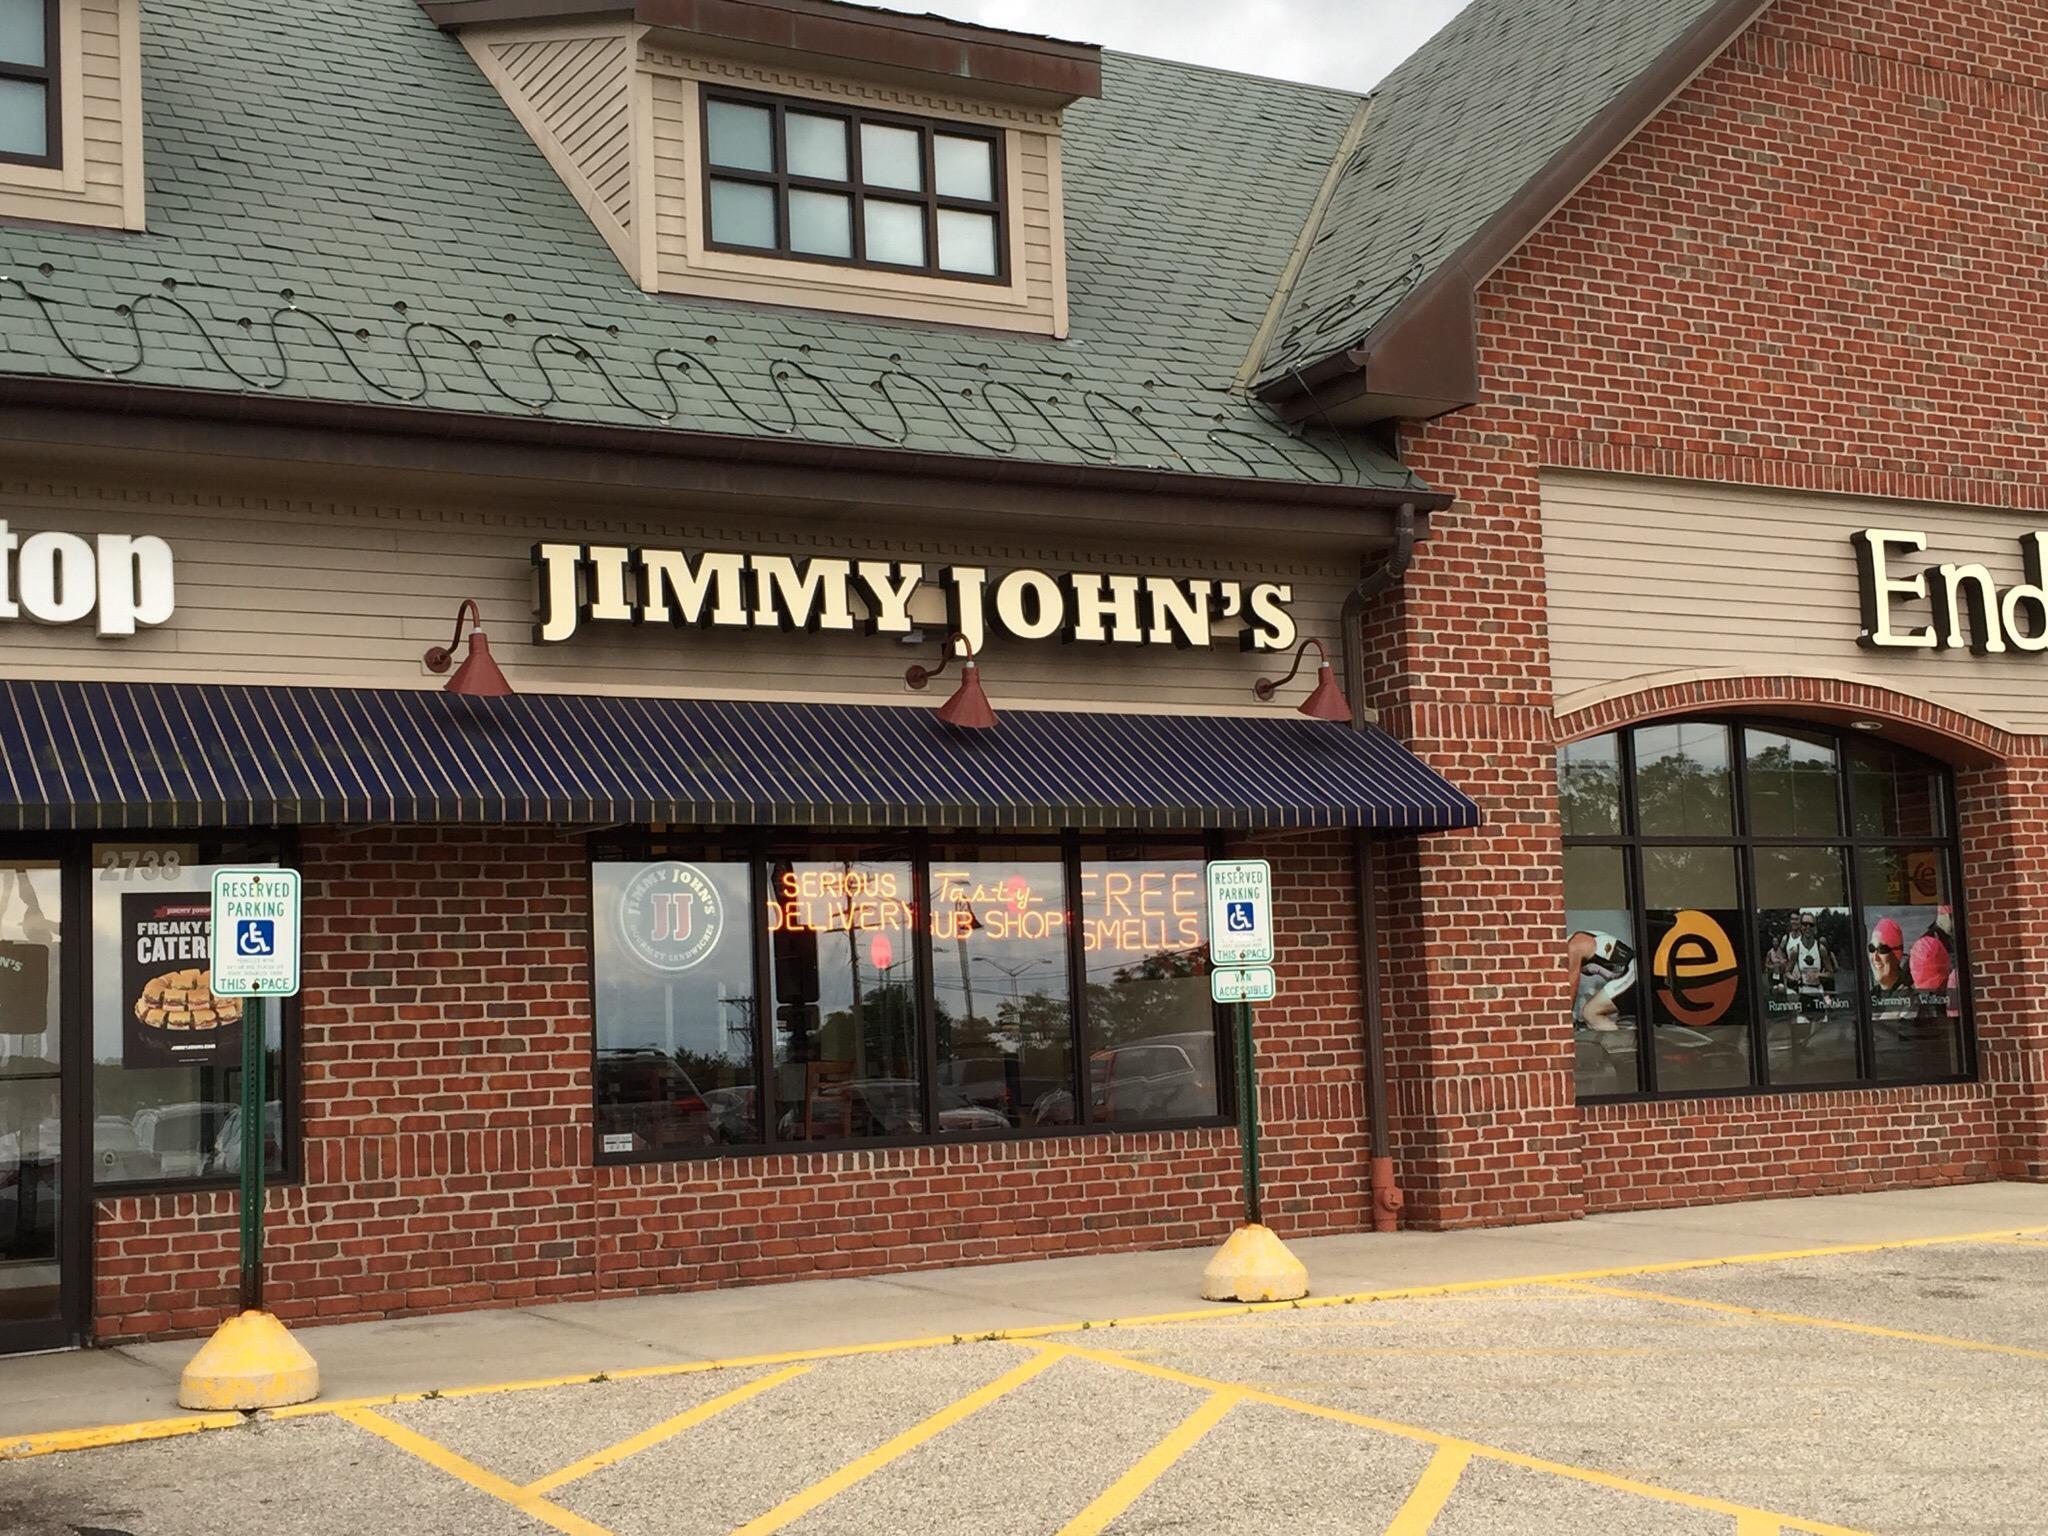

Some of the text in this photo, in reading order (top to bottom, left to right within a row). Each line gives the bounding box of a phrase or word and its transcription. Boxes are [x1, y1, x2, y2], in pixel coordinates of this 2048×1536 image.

[1862, 528, 2048, 653] End
[538, 543, 1298, 657] JIMMY JOHN'S
[100, 850, 182, 881] 2738
[783, 871, 897, 898] SERIOUS
[1215, 871, 1263, 884] RESERVED
[222, 882, 290, 898] RESERVED
[628, 868, 715, 915] JIMMY JOHN'S
[934, 872, 1043, 910] Tasty
[1219, 887, 1260, 900] PARKING
[227, 902, 285, 917] PARKING
[651, 893, 694, 941] JJ
[766, 900, 914, 932] DELIVERY
[137, 921, 202, 936] FREAKY
[930, 910, 1064, 939] UB SHOP
[1082, 917, 1199, 951] SMELLS
[1217, 949, 1237, 960] THIS
[220, 978, 247, 990] THIS
[1234, 973, 1252, 983] VAN
[1219, 984, 1269, 997] ACCESSIBLE
[1768, 1000, 1803, 1012] Running
[1871, 995, 1911, 1008] Swimming
